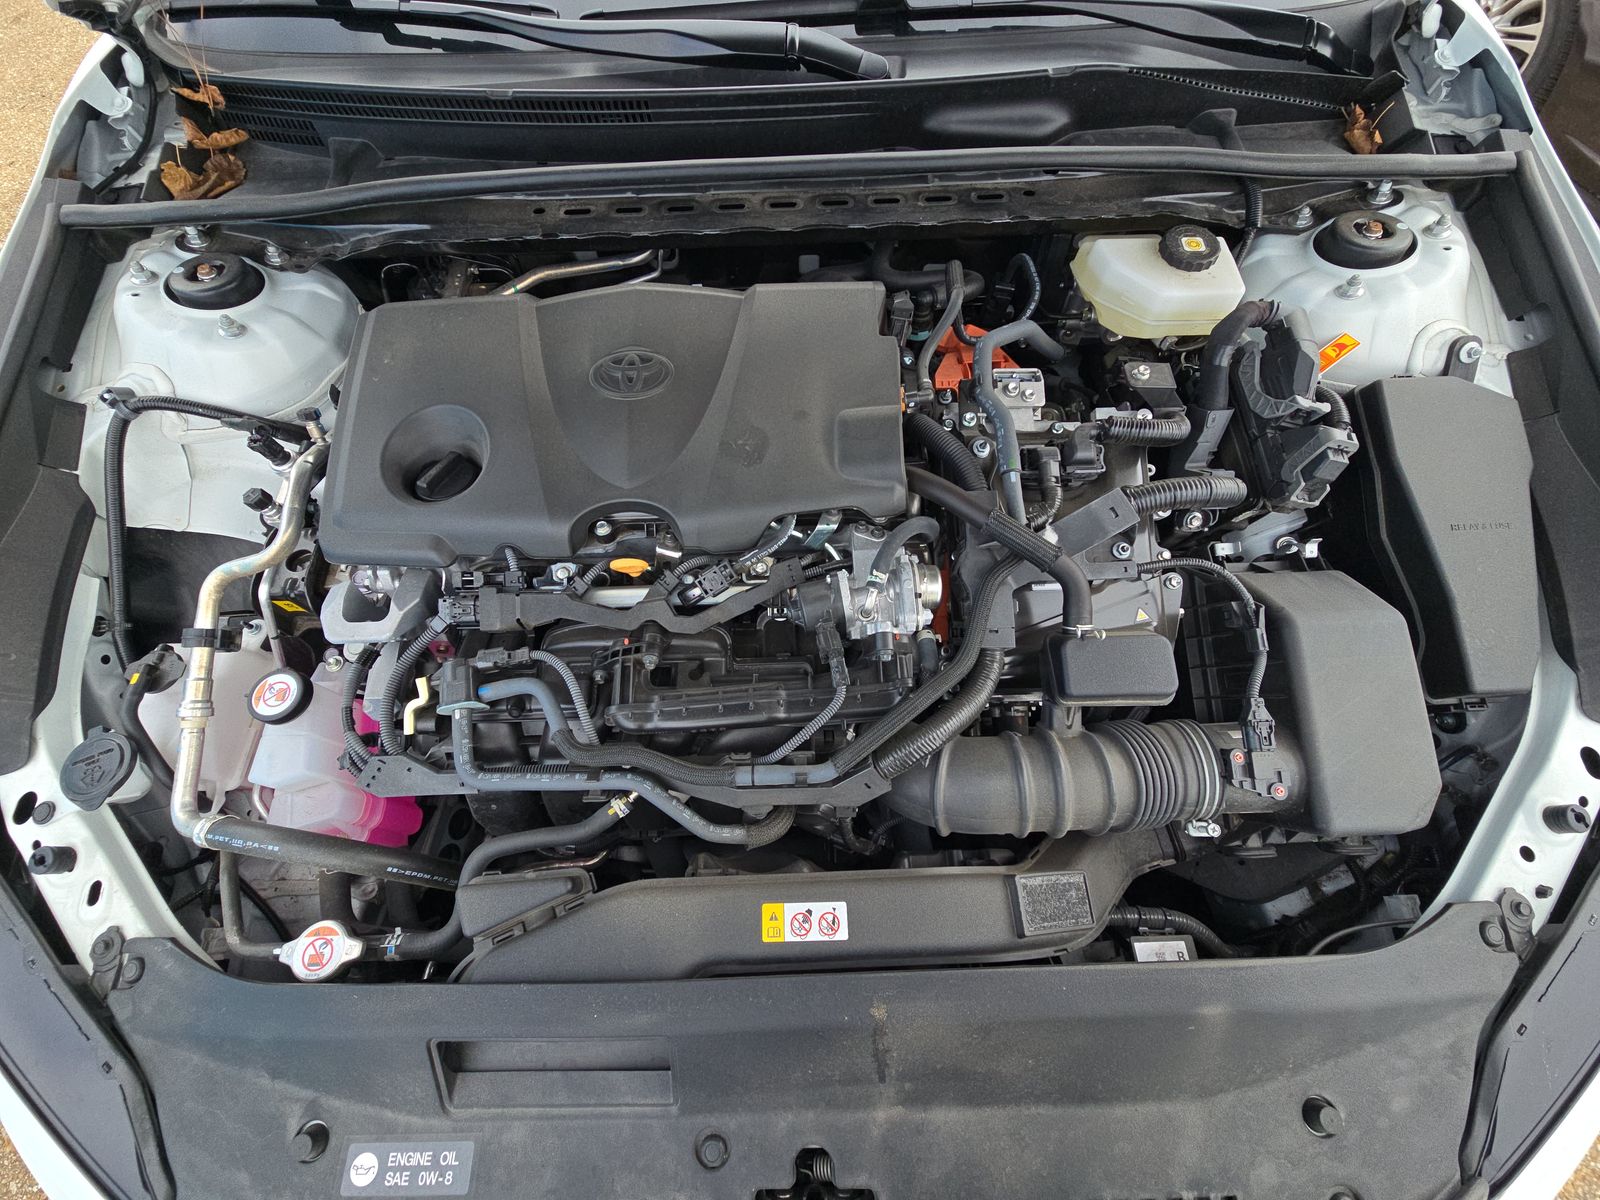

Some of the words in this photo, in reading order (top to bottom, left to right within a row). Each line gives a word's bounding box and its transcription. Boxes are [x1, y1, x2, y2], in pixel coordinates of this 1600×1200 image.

[387, 1151, 433, 1167] ENGINE
[439, 1151, 459, 1166] OIL
[384, 1171, 411, 1186] SAE
[418, 1171, 453, 1186] 0W-8
